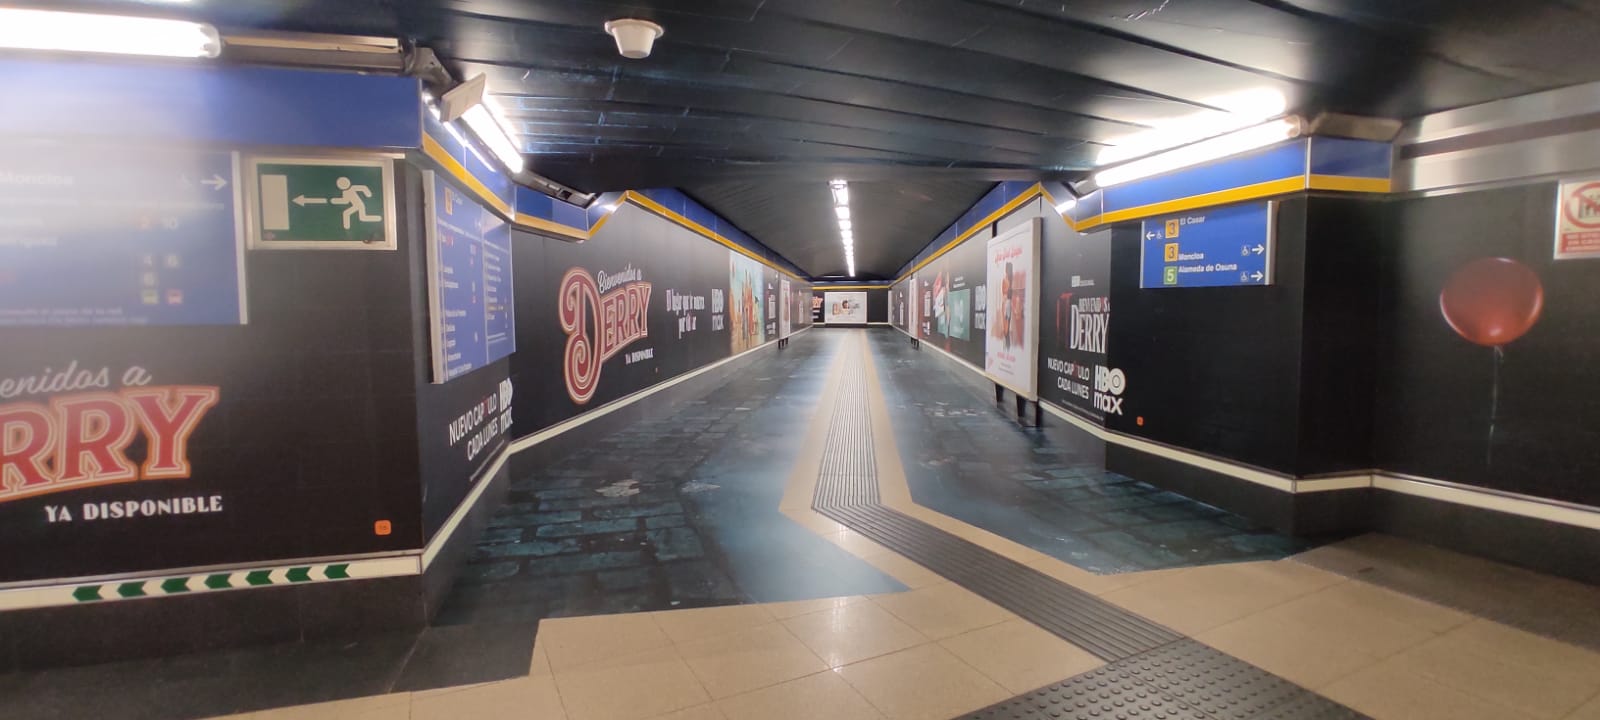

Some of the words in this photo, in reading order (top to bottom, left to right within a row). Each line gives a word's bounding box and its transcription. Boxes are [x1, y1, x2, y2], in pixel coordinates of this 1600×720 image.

[598, 262, 635, 293] Bienvenidos
[1179, 264, 1204, 273] Alameda
[1205, 264, 1214, 272] de
[1216, 263, 1237, 271] Osuna
[559, 266, 652, 404] DERRY
[1070, 304, 1110, 354] DERRY
[123, 365, 152, 387] a
[1047, 357, 1064, 373] NUEVO
[499, 377, 513, 412] HBO
[1057, 376, 1071, 391] CADA
[1071, 381, 1089, 400] LUNES
[1095, 365, 1126, 395] HBO
[1093, 391, 1123, 416] max
[449, 410, 473, 447] NUEVO
[500, 406, 513, 434] max
[467, 431, 484, 461] CADA
[483, 416, 498, 446] LUNES
[44, 504, 72, 523] YA
[83, 495, 223, 521] DISPONIBLE
